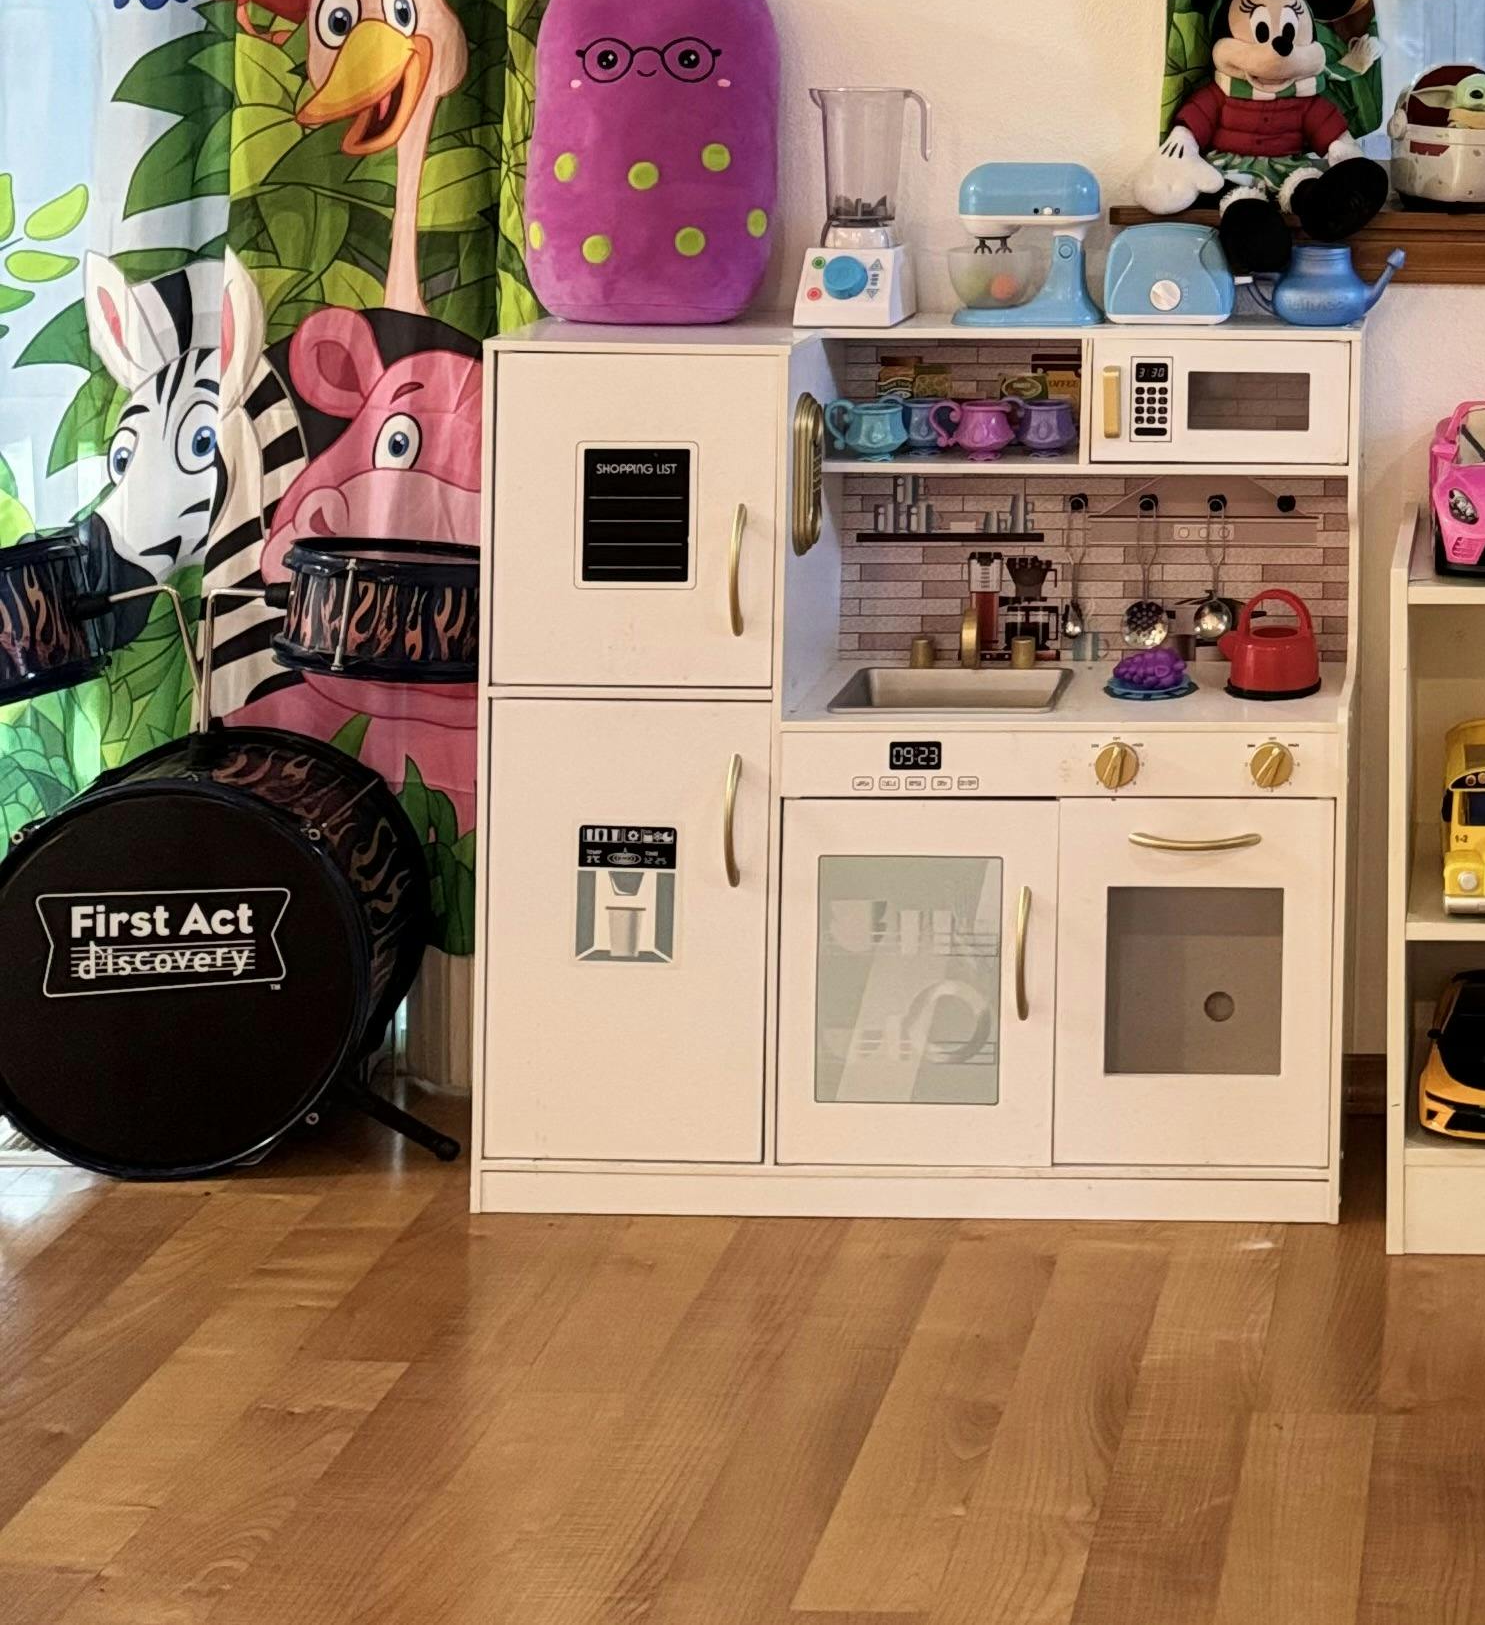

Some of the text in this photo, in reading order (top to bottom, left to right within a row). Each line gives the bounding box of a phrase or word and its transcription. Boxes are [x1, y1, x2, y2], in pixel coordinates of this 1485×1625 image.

[596, 463, 678, 475] SHOPPING LIST
[892, 746, 939, 766] 09:23
[1455, 834, 1468, 843] 1-2
[70, 902, 254, 938] First Act
[78, 940, 250, 980] discovery
